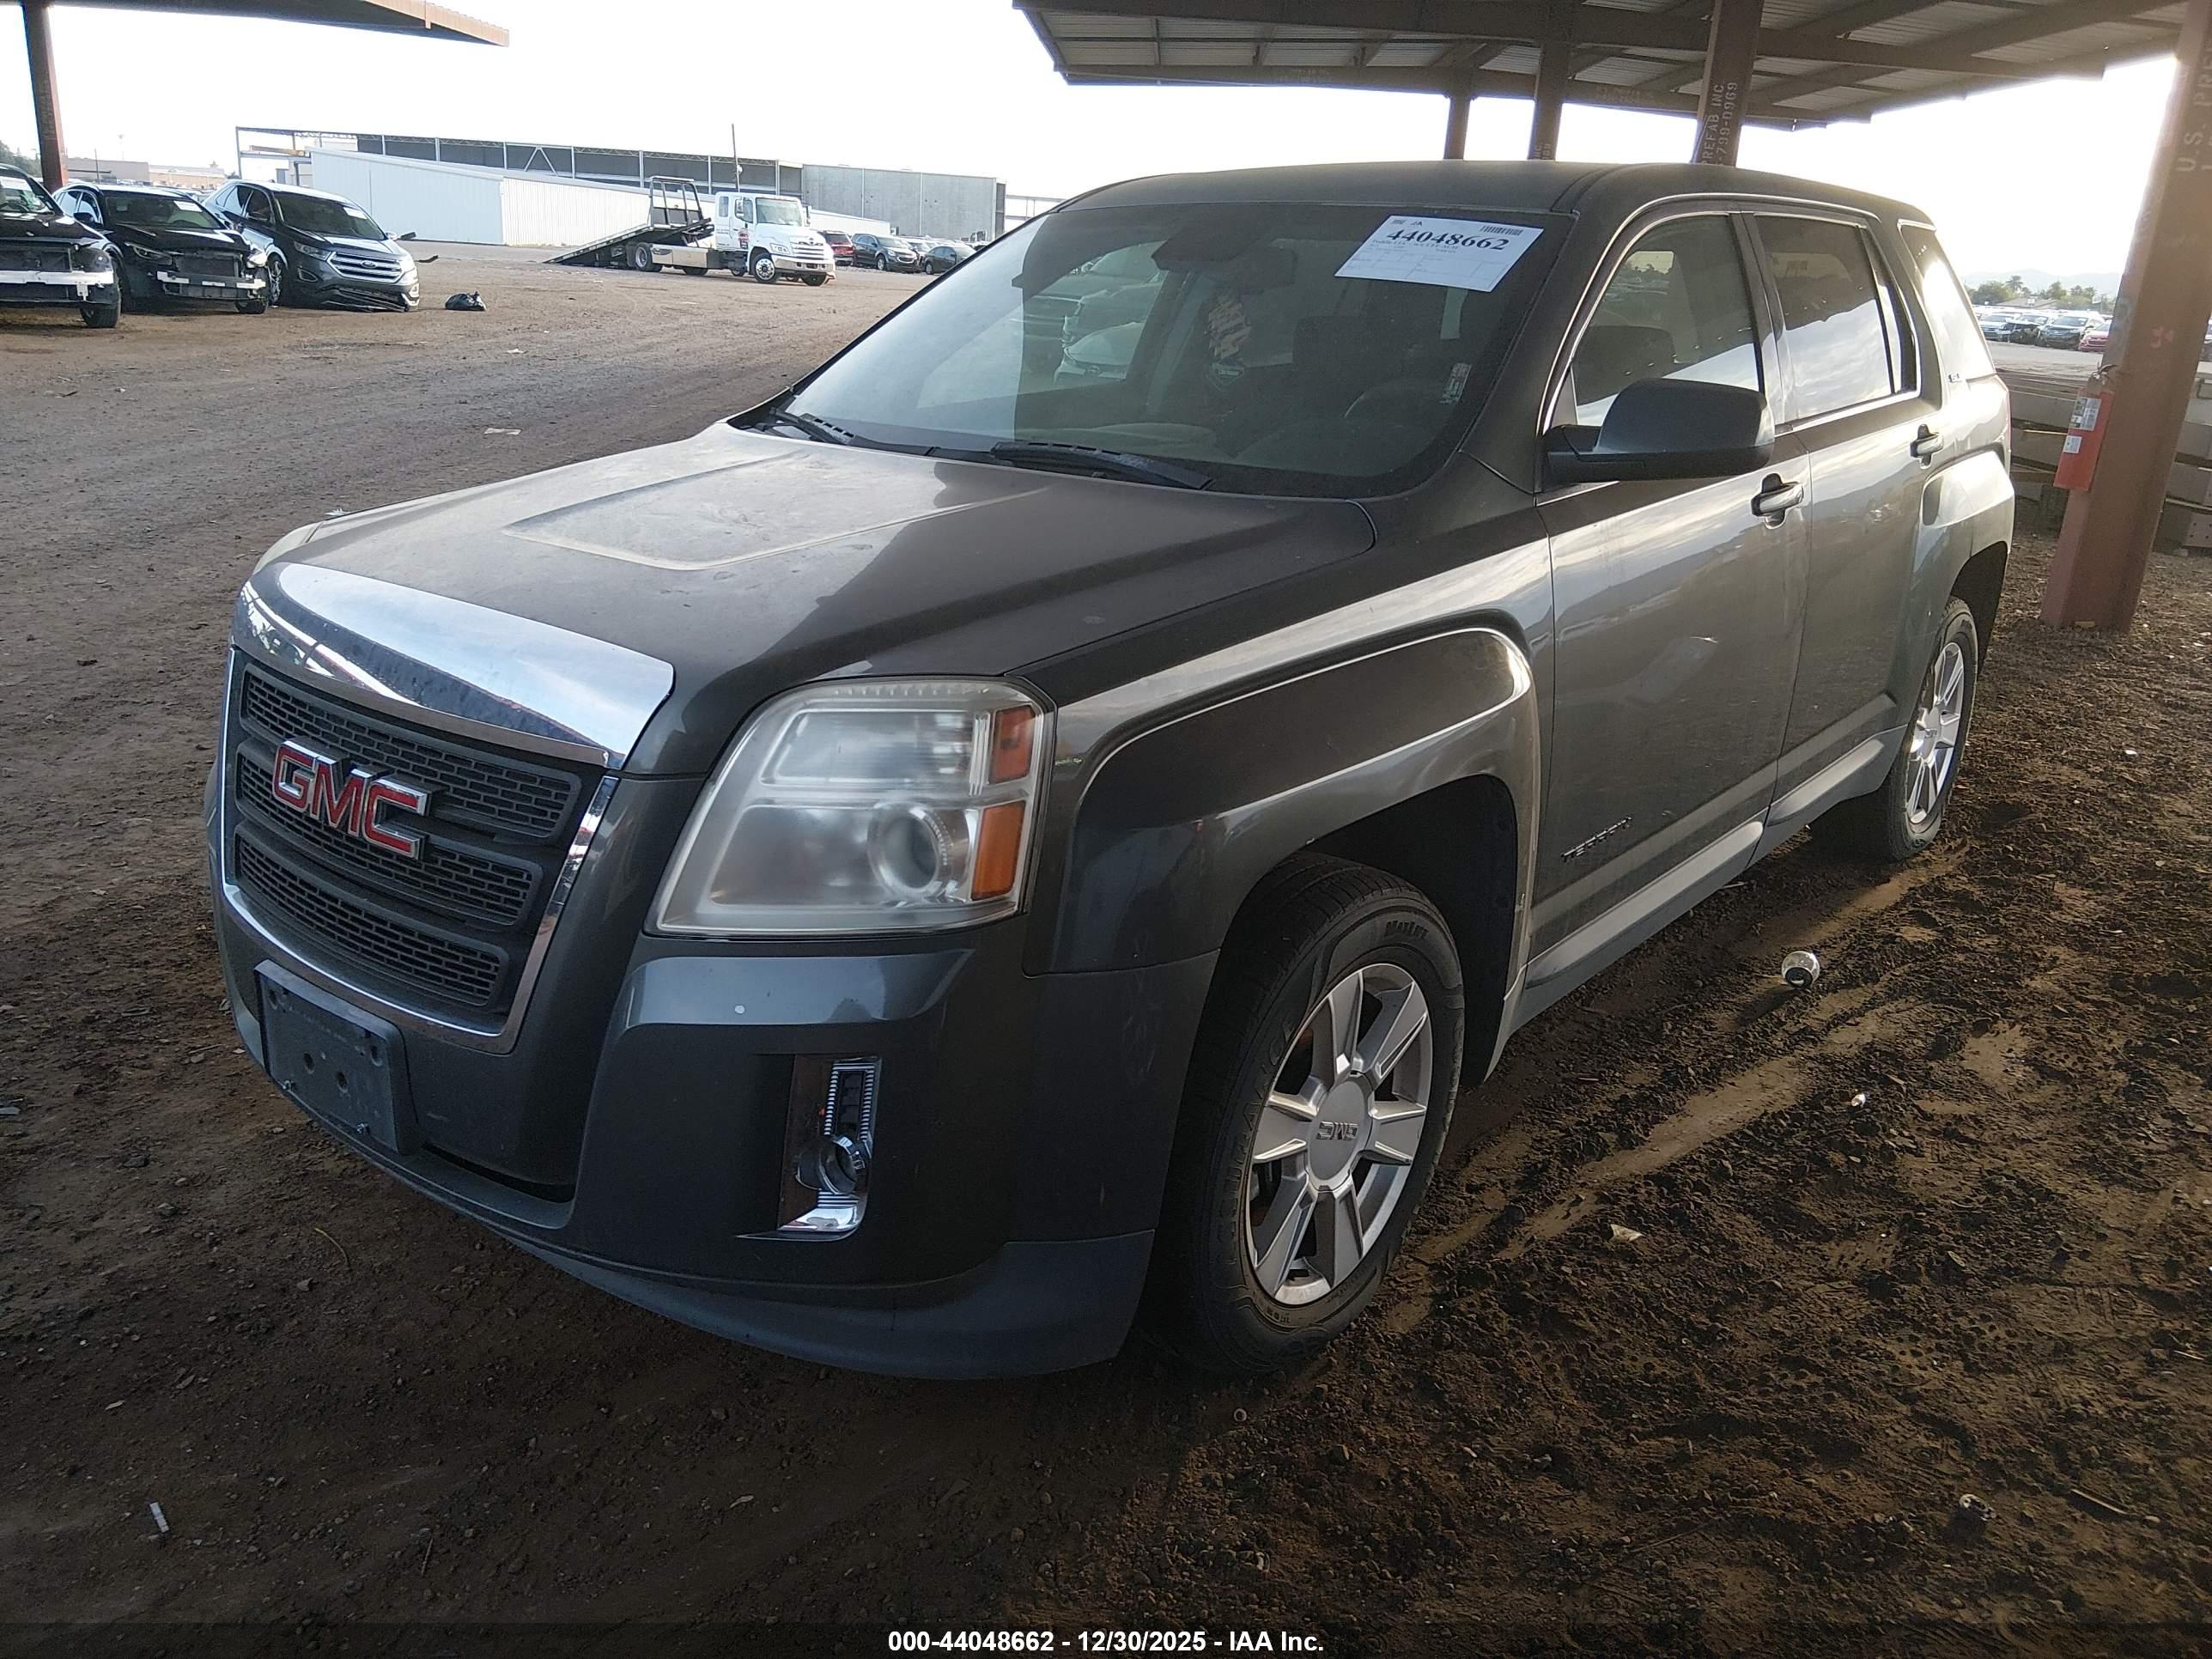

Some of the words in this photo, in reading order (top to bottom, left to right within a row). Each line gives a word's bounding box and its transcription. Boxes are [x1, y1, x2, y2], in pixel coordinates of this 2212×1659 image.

[1387, 228, 1510, 251] 44048662
[271, 738, 428, 860] GMC
[1316, 1121, 1360, 1140] GMC
